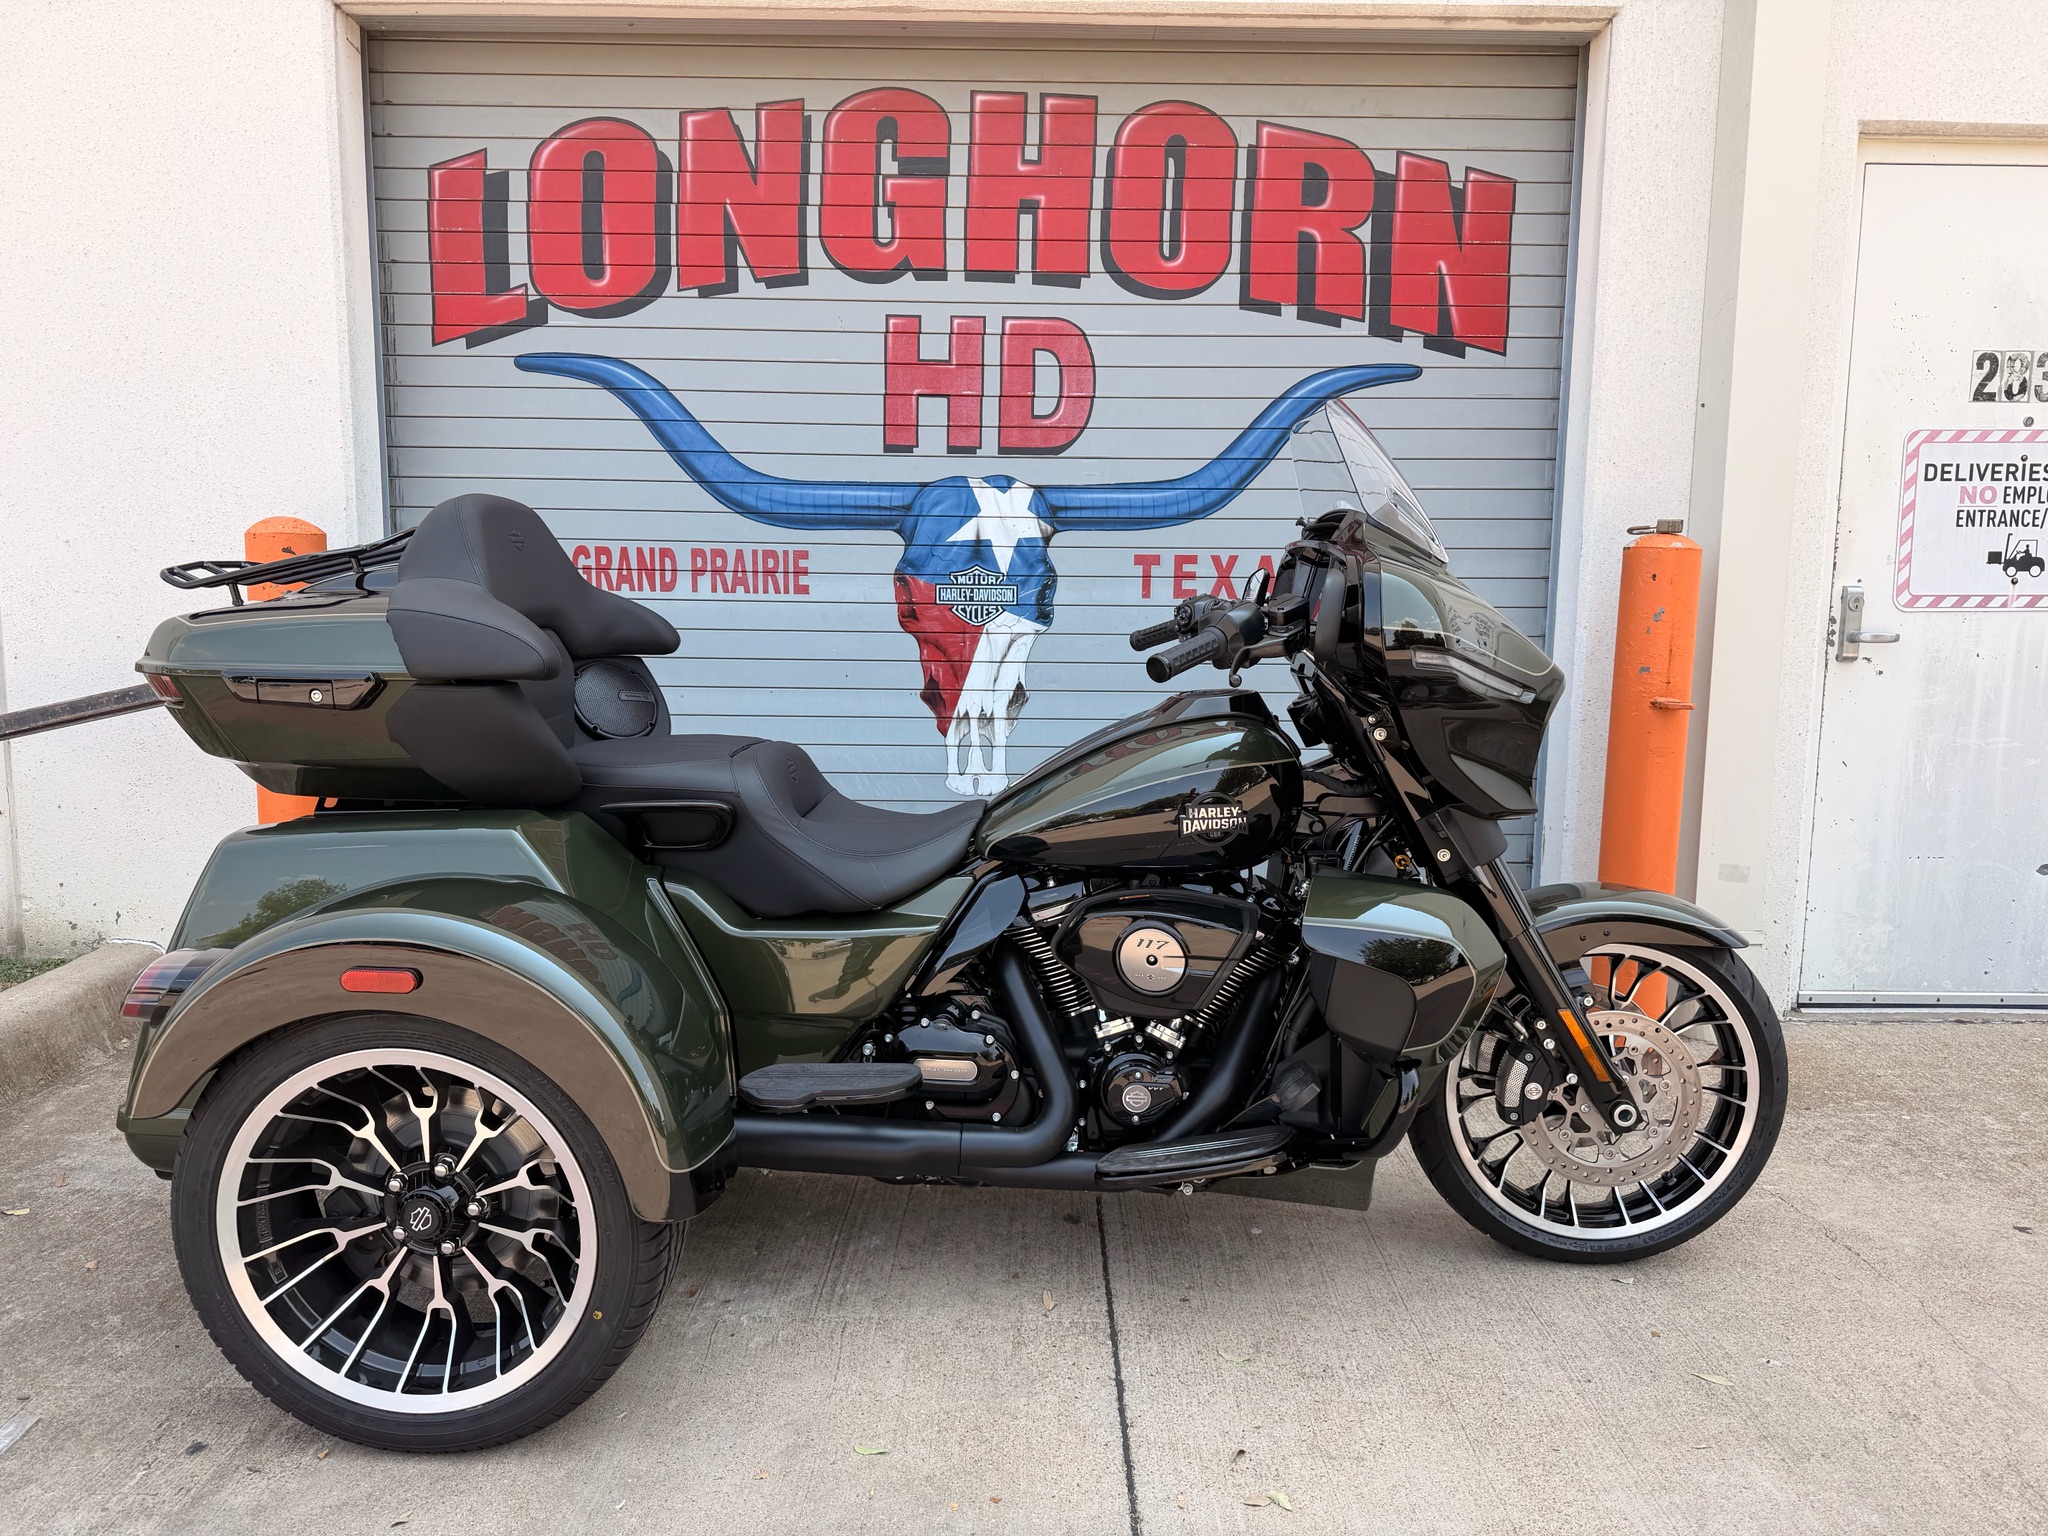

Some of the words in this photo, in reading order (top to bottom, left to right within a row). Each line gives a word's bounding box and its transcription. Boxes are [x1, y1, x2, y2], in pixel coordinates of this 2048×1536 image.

[428, 86, 1517, 357] LONGHORN
[883, 314, 1096, 455] HD
[1959, 485, 1998, 505] NO
[2003, 485, 2048, 504] EMPL
[571, 544, 677, 592] GRAND
[690, 547, 810, 595] PRAIRIE
[957, 571, 996, 585] MOTOR
[940, 588, 1014, 602] HARLEY-DAVIDSON
[958, 605, 997, 623] CYCLES
[1182, 817, 1247, 835] DAVIDSON
[1135, 938, 1170, 950] 117
